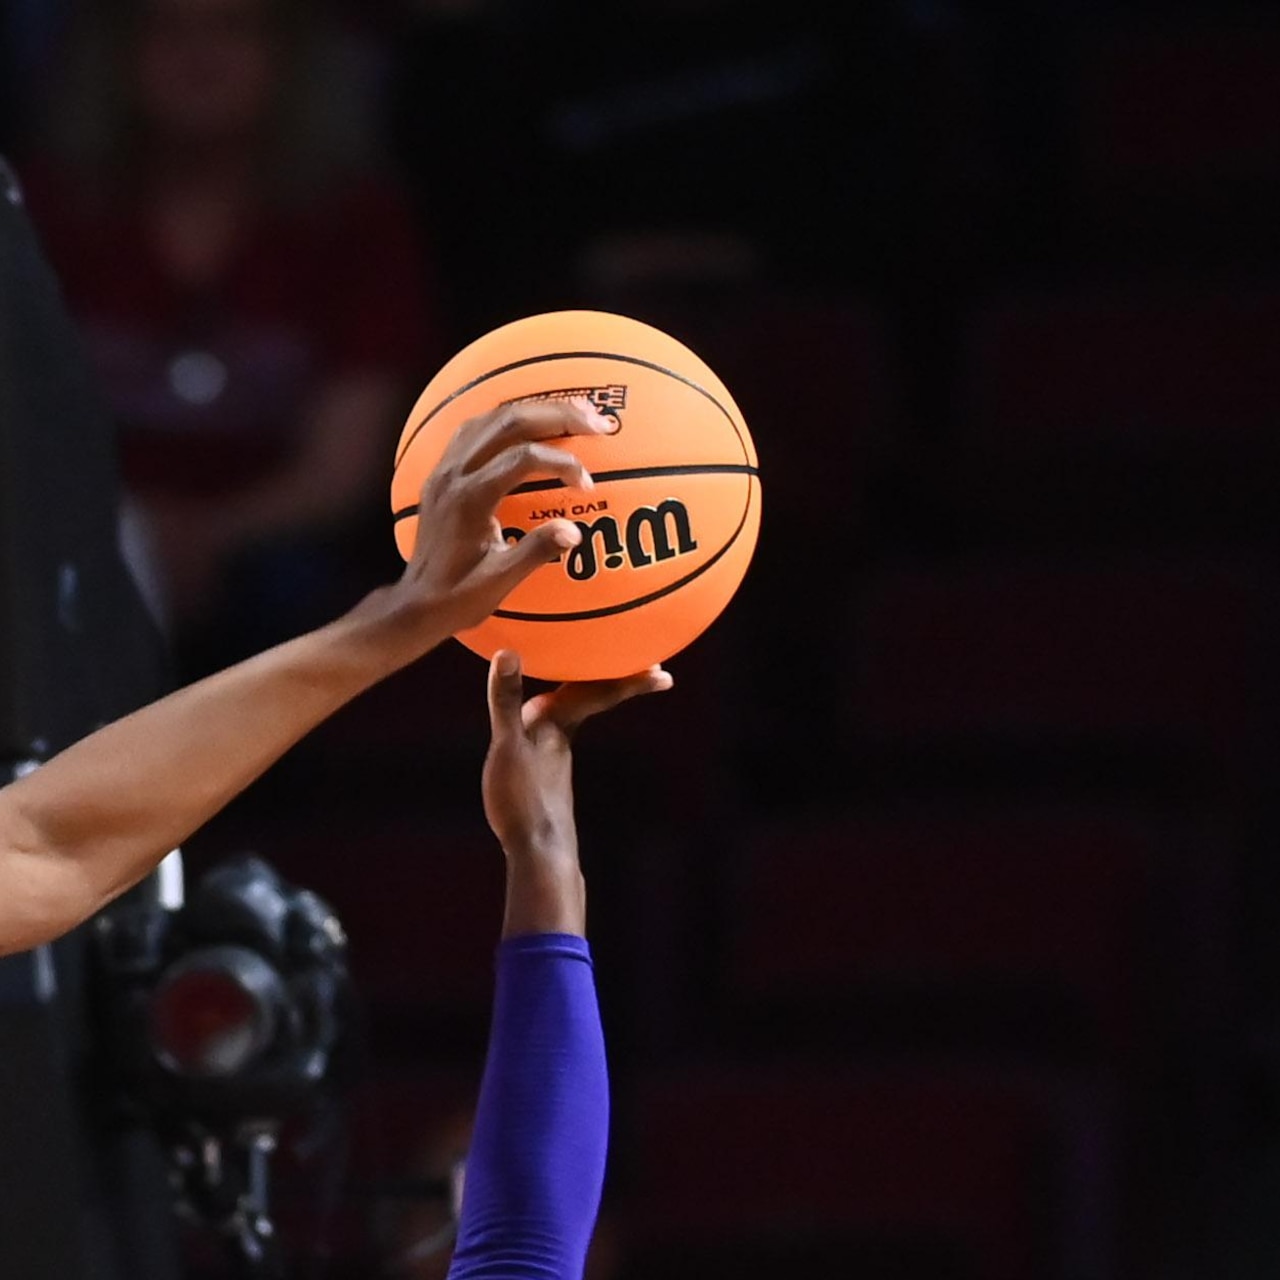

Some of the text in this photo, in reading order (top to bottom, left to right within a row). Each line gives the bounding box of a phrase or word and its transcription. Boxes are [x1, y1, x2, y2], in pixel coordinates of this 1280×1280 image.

[528, 500, 608, 520] EVO NXT
[502, 497, 698, 582] Wil
